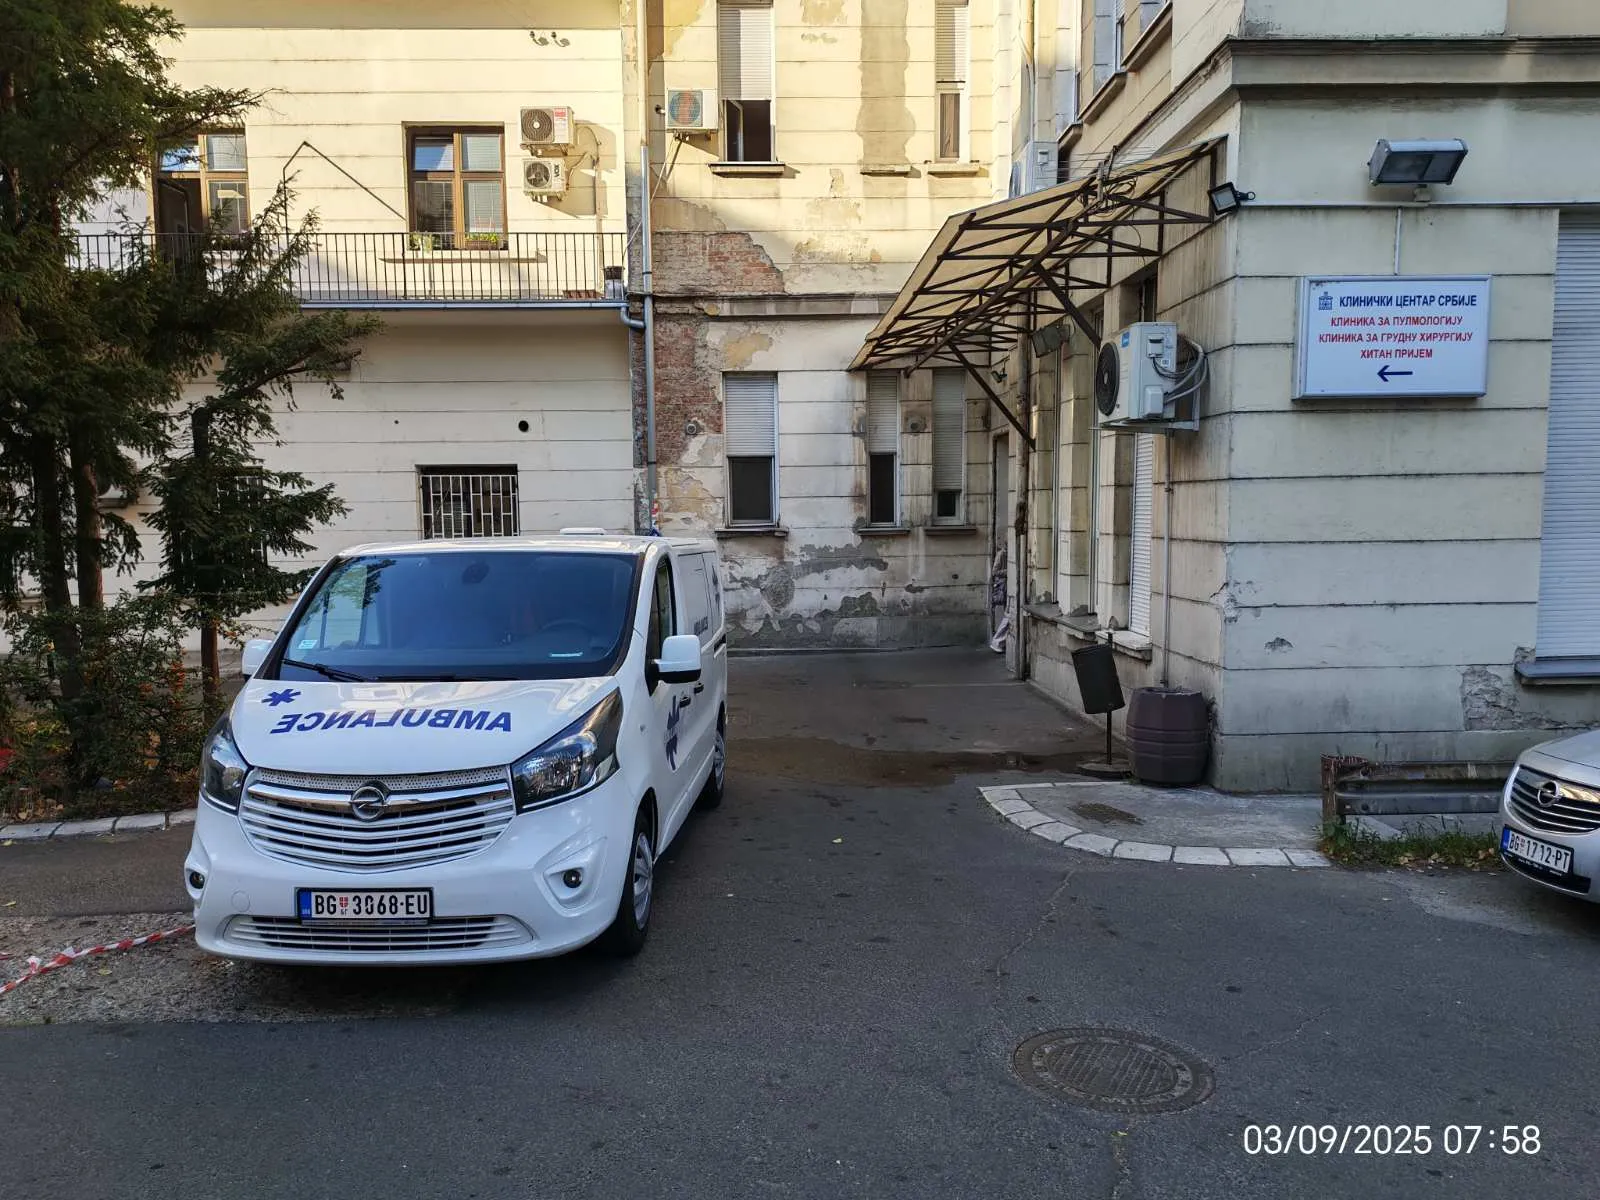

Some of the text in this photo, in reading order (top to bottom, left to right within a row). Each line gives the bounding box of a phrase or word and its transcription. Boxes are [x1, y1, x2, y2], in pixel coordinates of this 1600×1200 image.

[1339, 294, 1477, 308] КЛИНИЧКИ ЦЕНТАР СРБИЈЕ
[1331, 316, 1463, 326] КЛИНИКА ЗА ПУЛМОЛОГИЈУ
[1319, 332, 1473, 343] КЛИНИКА ЗА ГРУДНУ ХИРУРГИЈУ
[1360, 349, 1433, 359] ХИТАН ПРИЈЕМ
[1509, 833, 1520, 851] BG
[315, 895, 337, 915] BG
